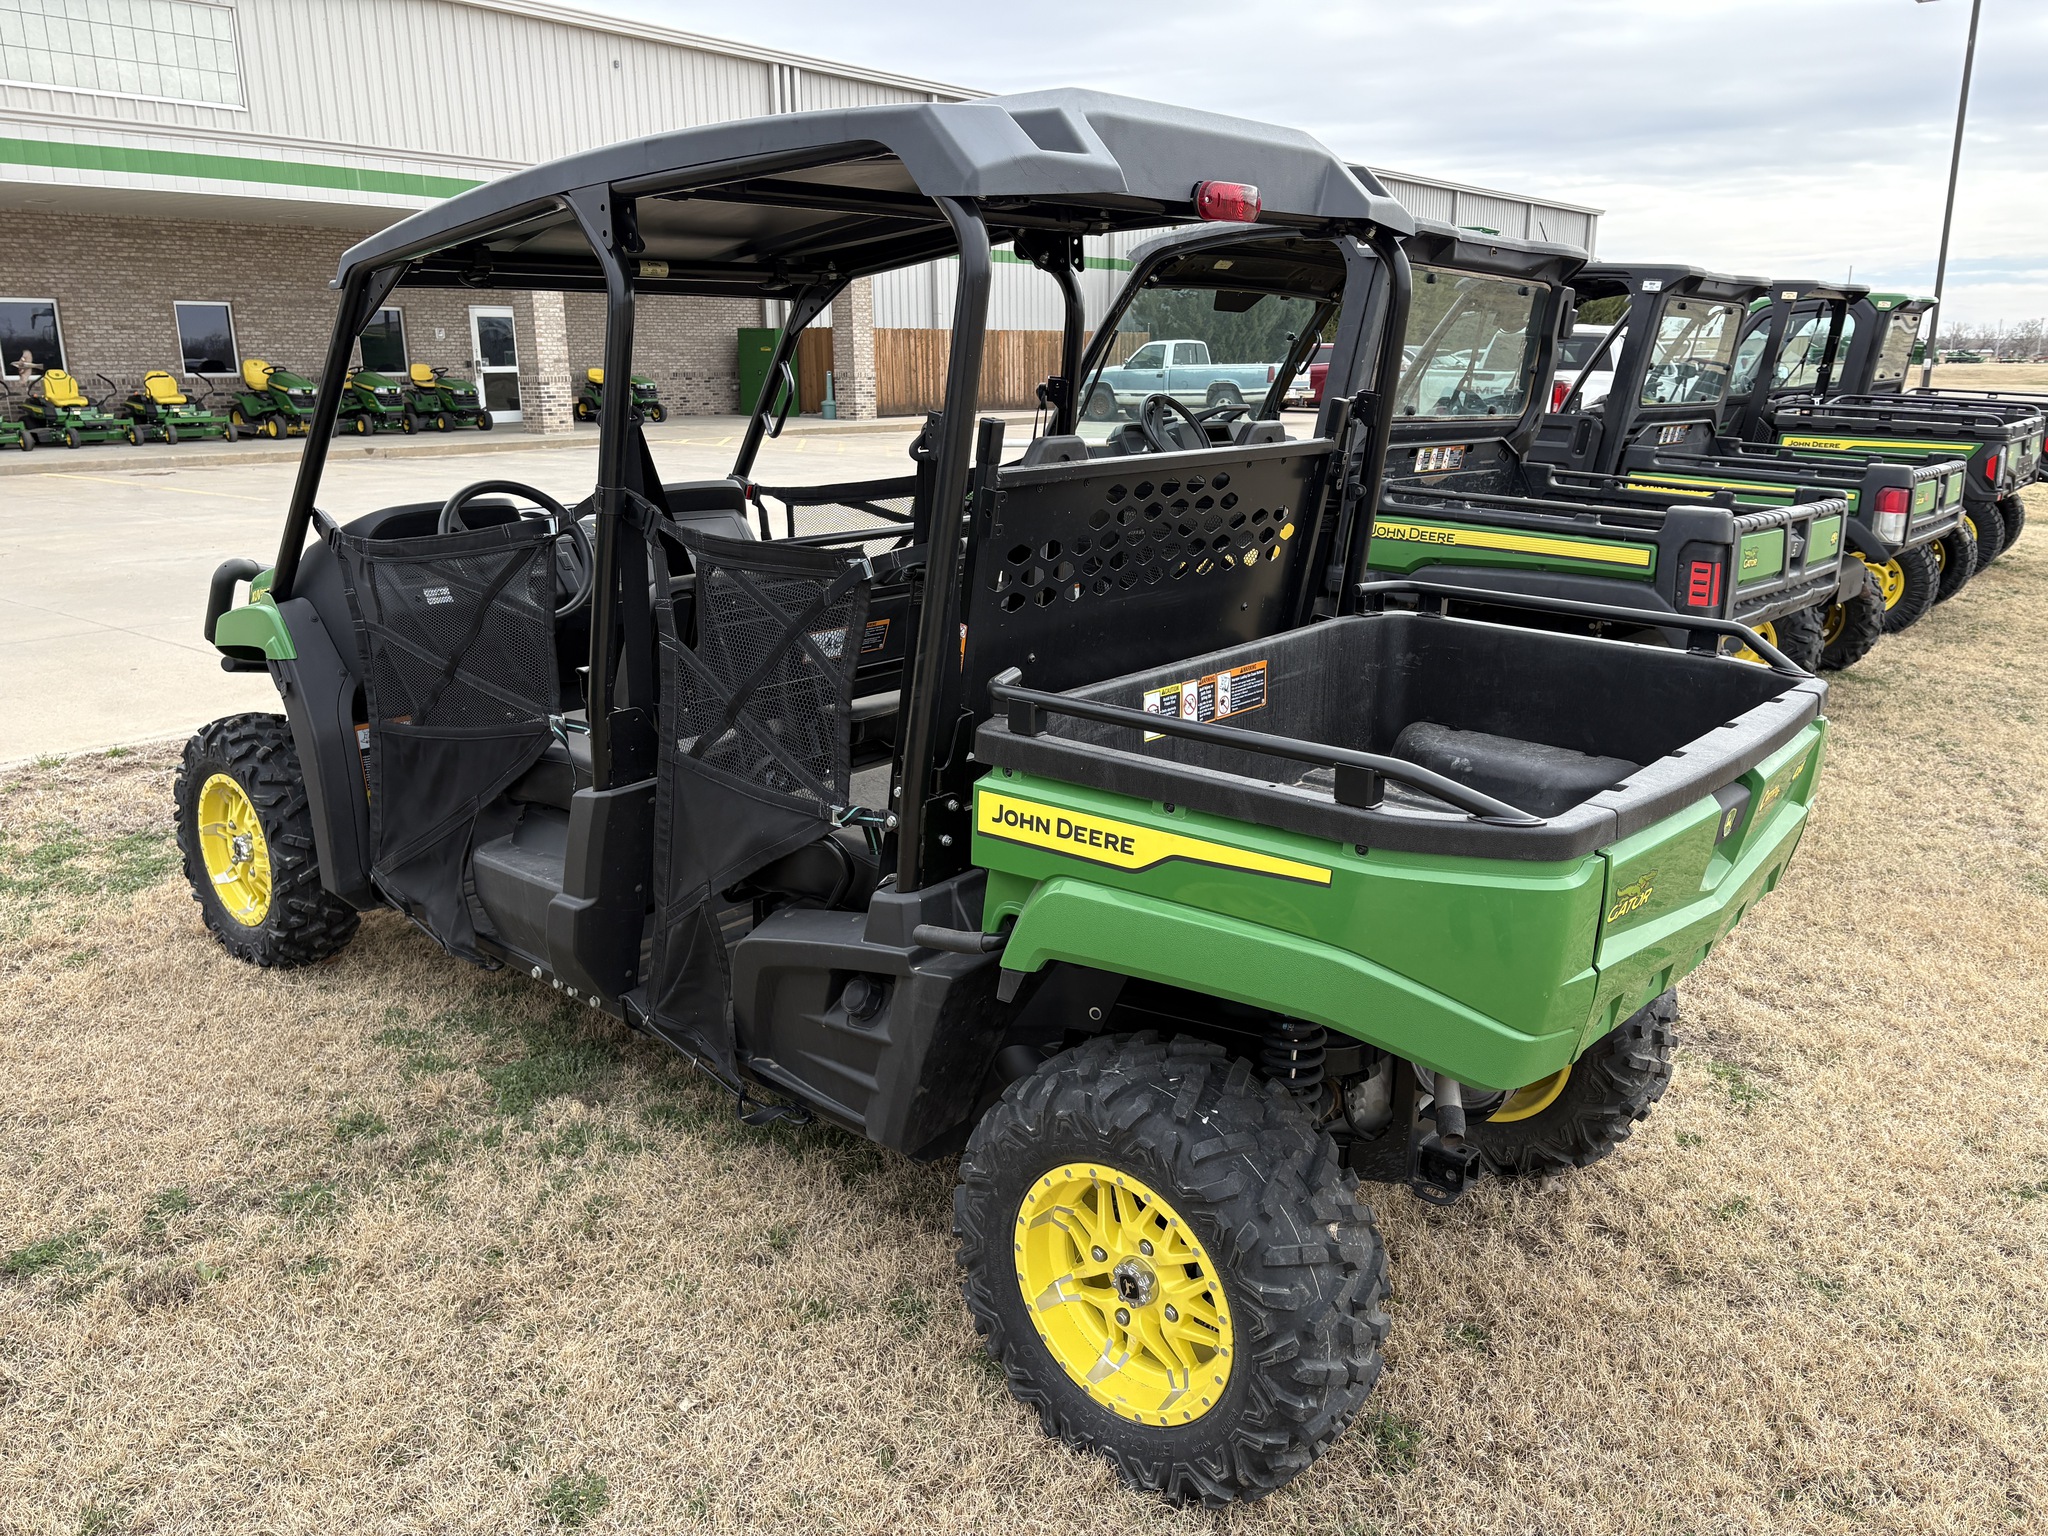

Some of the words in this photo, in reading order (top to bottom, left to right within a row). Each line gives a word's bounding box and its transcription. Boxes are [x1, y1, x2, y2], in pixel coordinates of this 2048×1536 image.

[1812, 441, 1840, 449] DEERE
[1372, 524, 1406, 539] JOHN
[1409, 527, 1455, 543] DEERE
[1164, 685, 1179, 695] CAUTION
[991, 804, 1051, 835] JOHN
[1056, 817, 1135, 856] DEERE
[1607, 887, 1653, 923] GATOR
